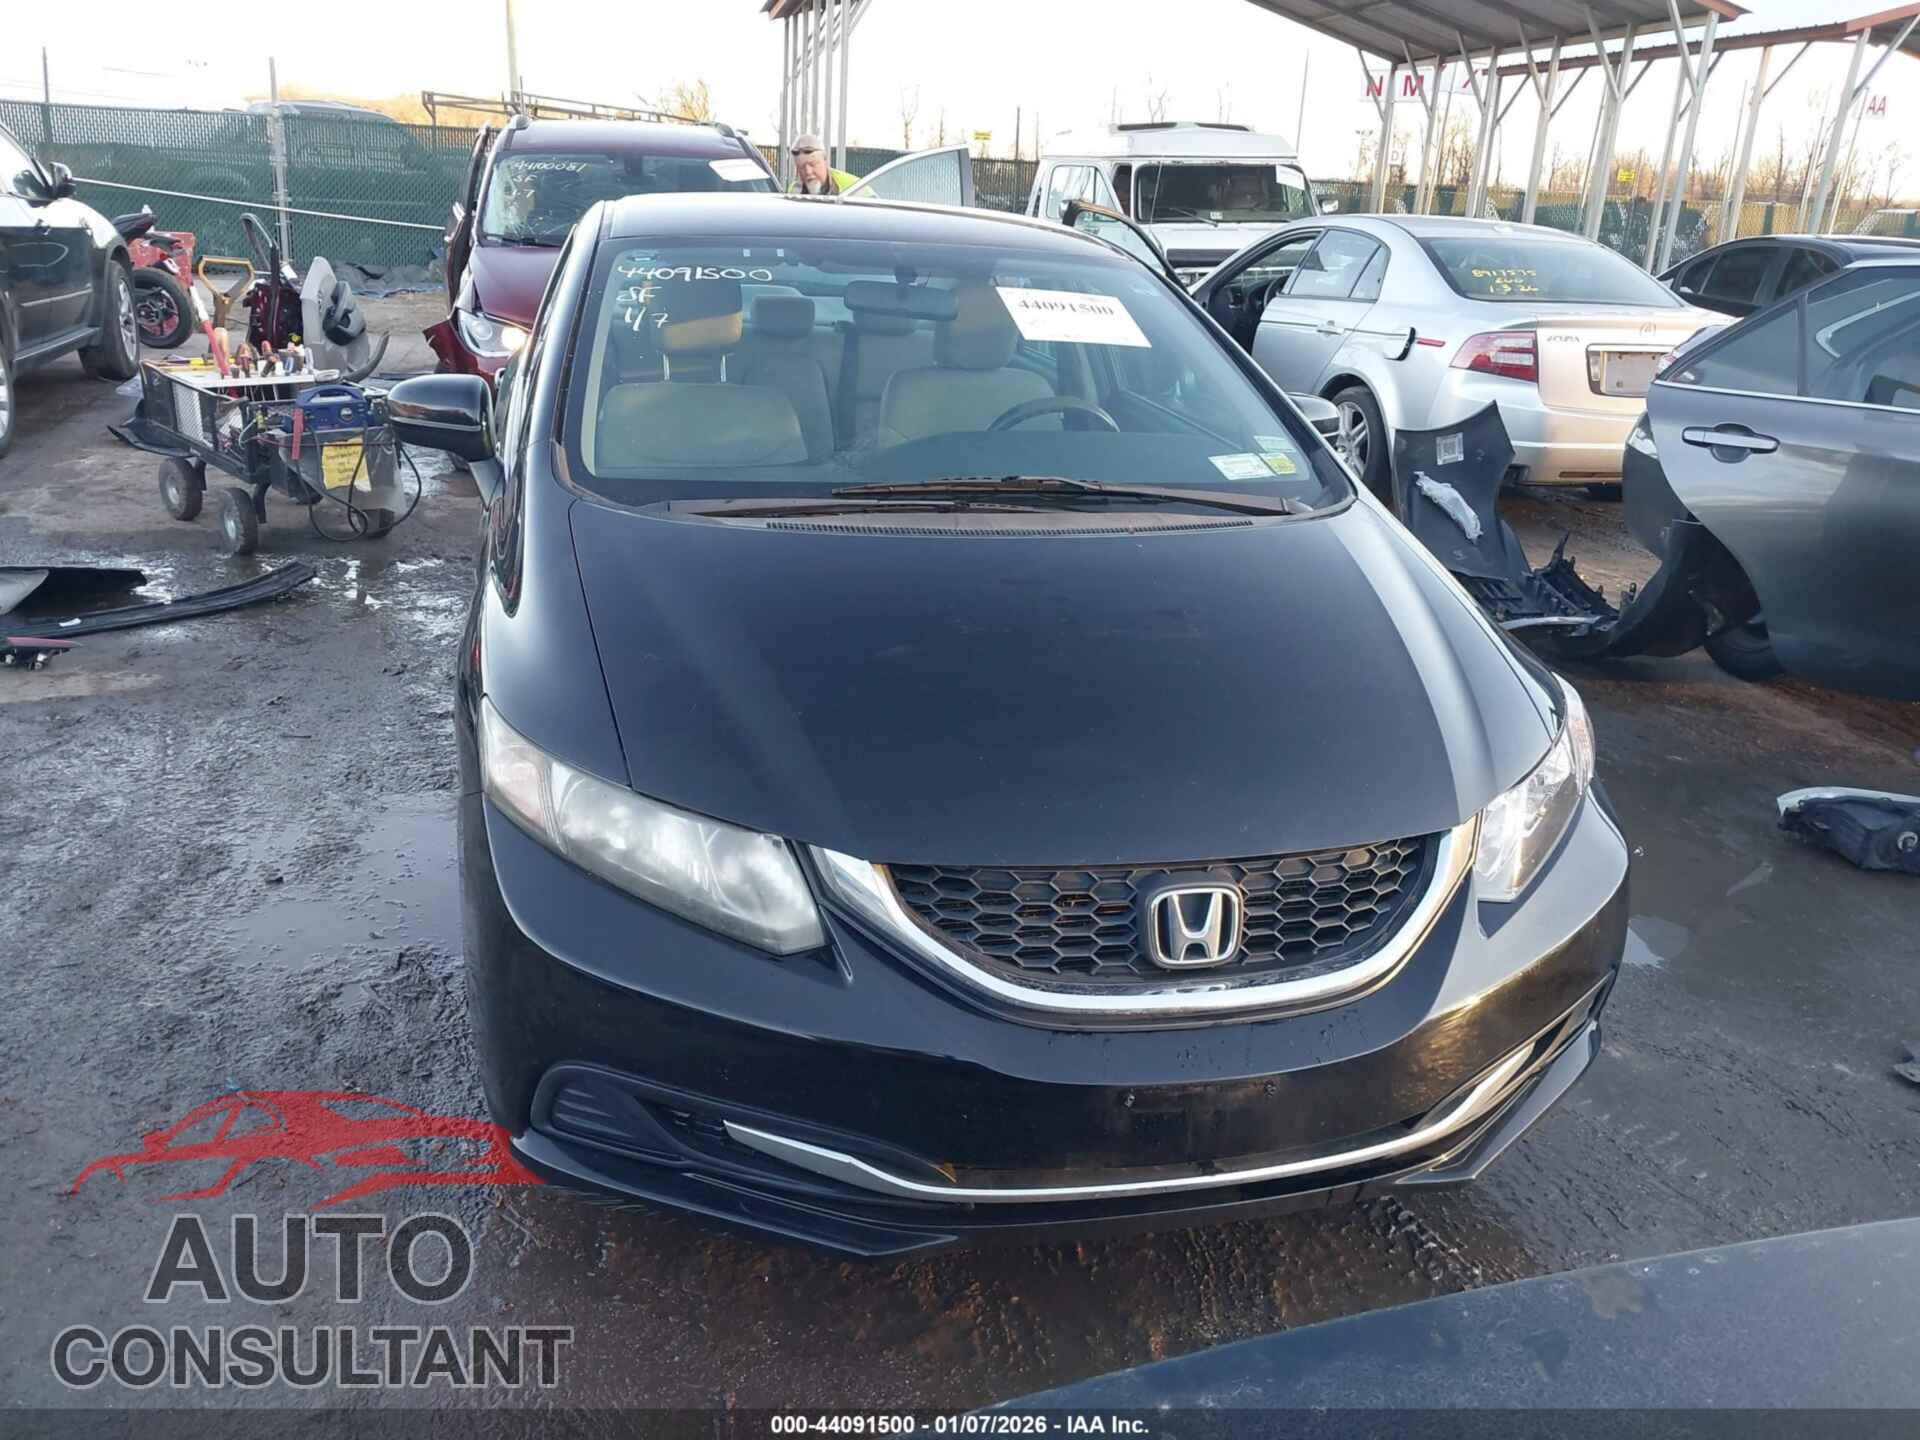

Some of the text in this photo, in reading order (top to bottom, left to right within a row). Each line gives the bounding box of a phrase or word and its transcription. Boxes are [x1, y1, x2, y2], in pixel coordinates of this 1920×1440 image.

[1366, 75, 1384, 97] N
[1403, 74, 1425, 97] M
[617, 265, 773, 282] 44091500
[1018, 299, 1116, 316] 44091500
